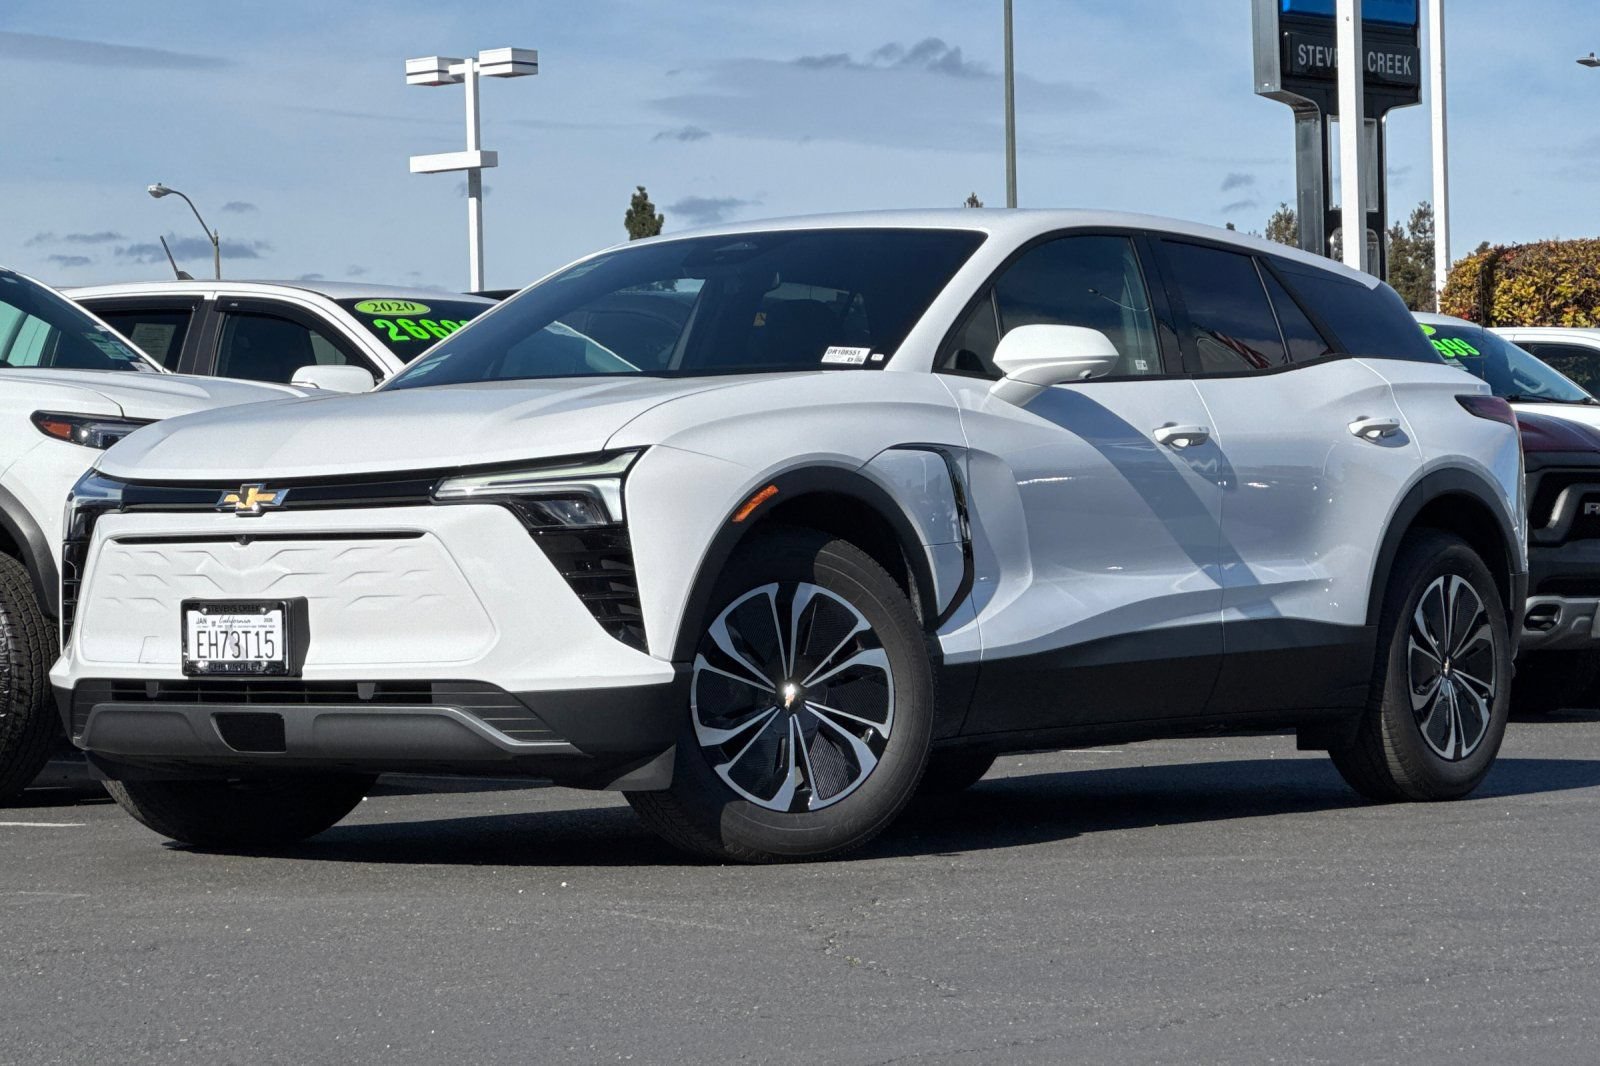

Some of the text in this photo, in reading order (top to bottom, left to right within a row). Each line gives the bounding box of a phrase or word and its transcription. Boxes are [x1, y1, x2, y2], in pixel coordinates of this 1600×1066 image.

[1367, 51, 1412, 75] CREEK
[368, 302, 415, 312] 2020
[197, 630, 275, 659] EH73T15
